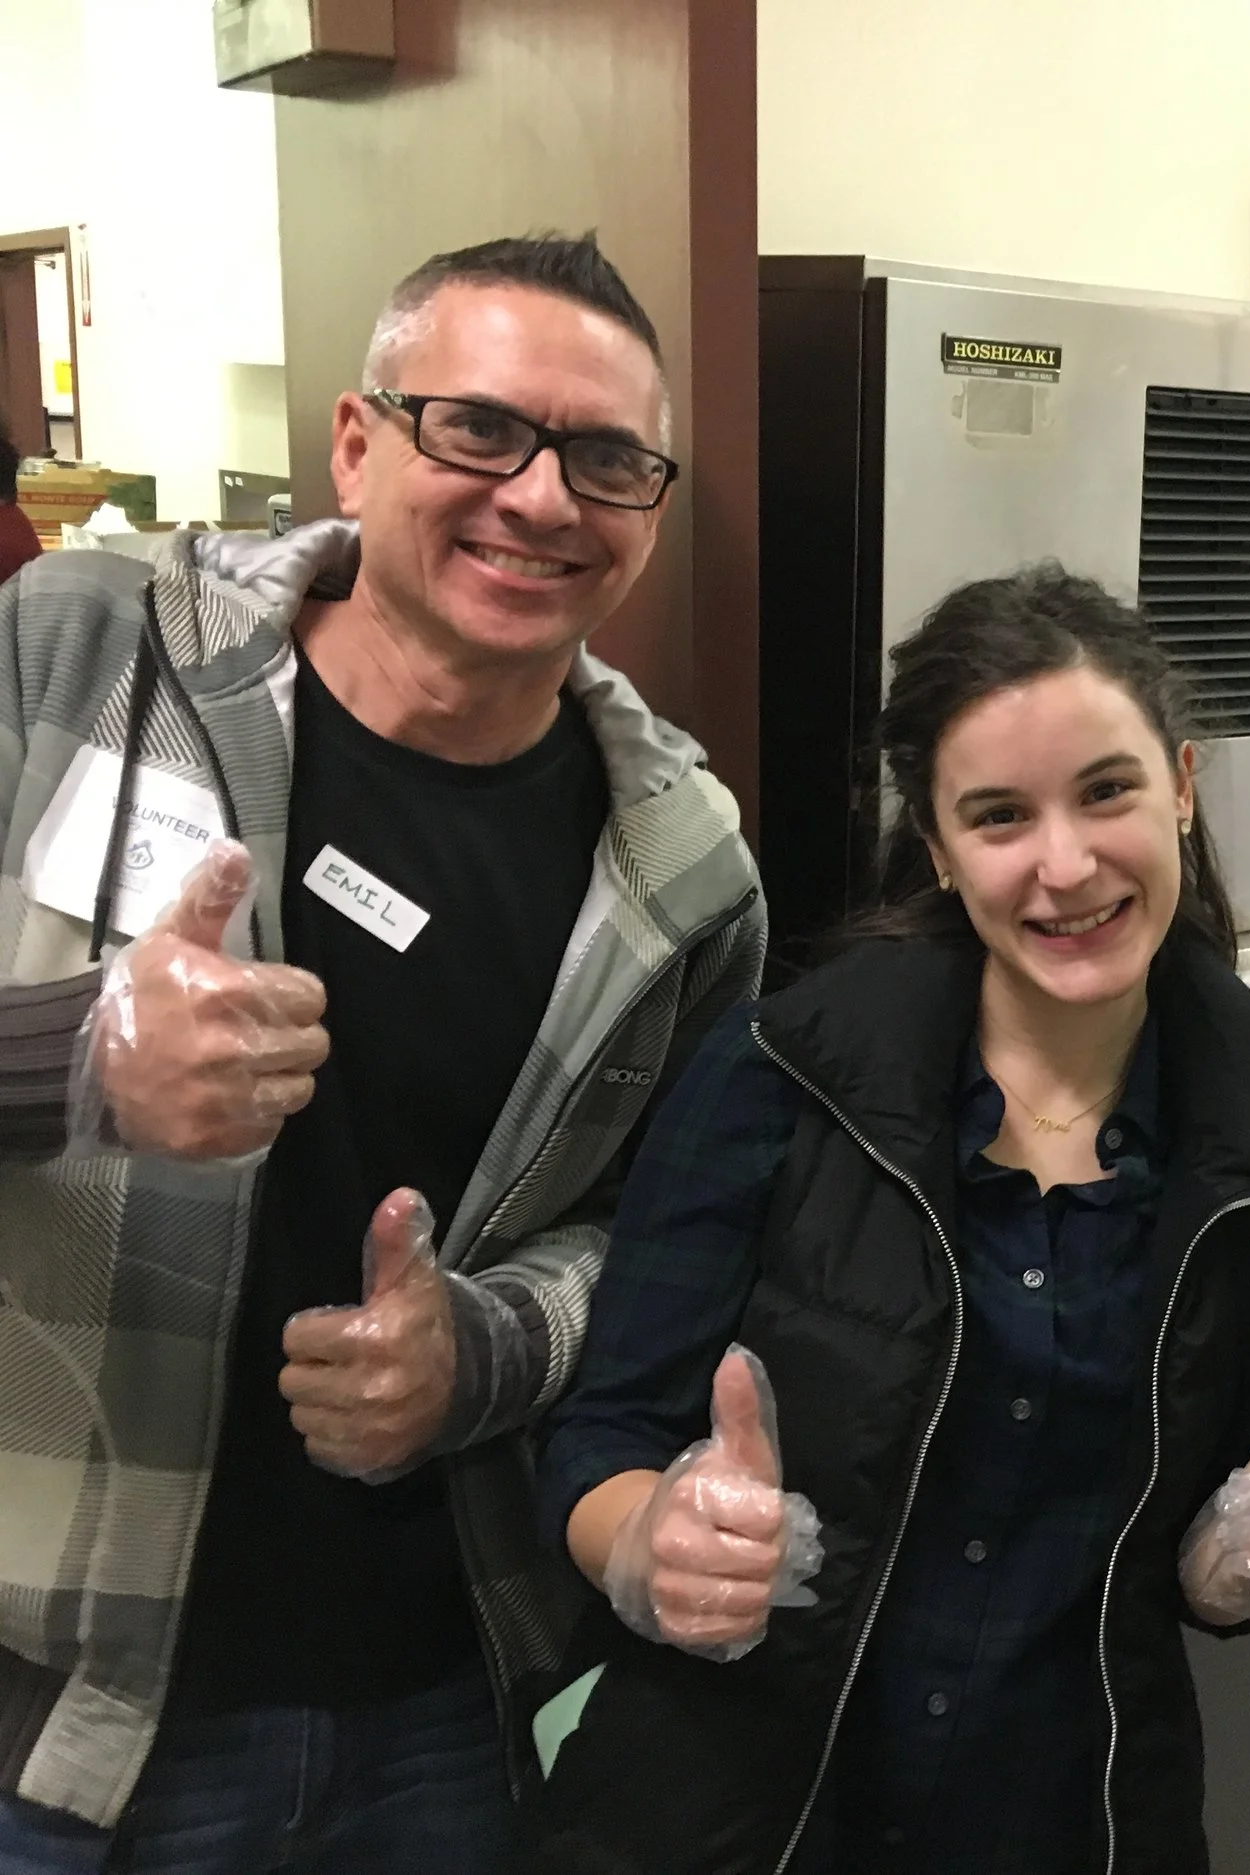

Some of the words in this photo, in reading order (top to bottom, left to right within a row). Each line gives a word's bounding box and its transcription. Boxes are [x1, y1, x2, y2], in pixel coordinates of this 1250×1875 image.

[953, 342, 1055, 365] HOSHIZAKI
[971, 367, 998, 376] NUMBER
[322, 863, 396, 926] EMIL
